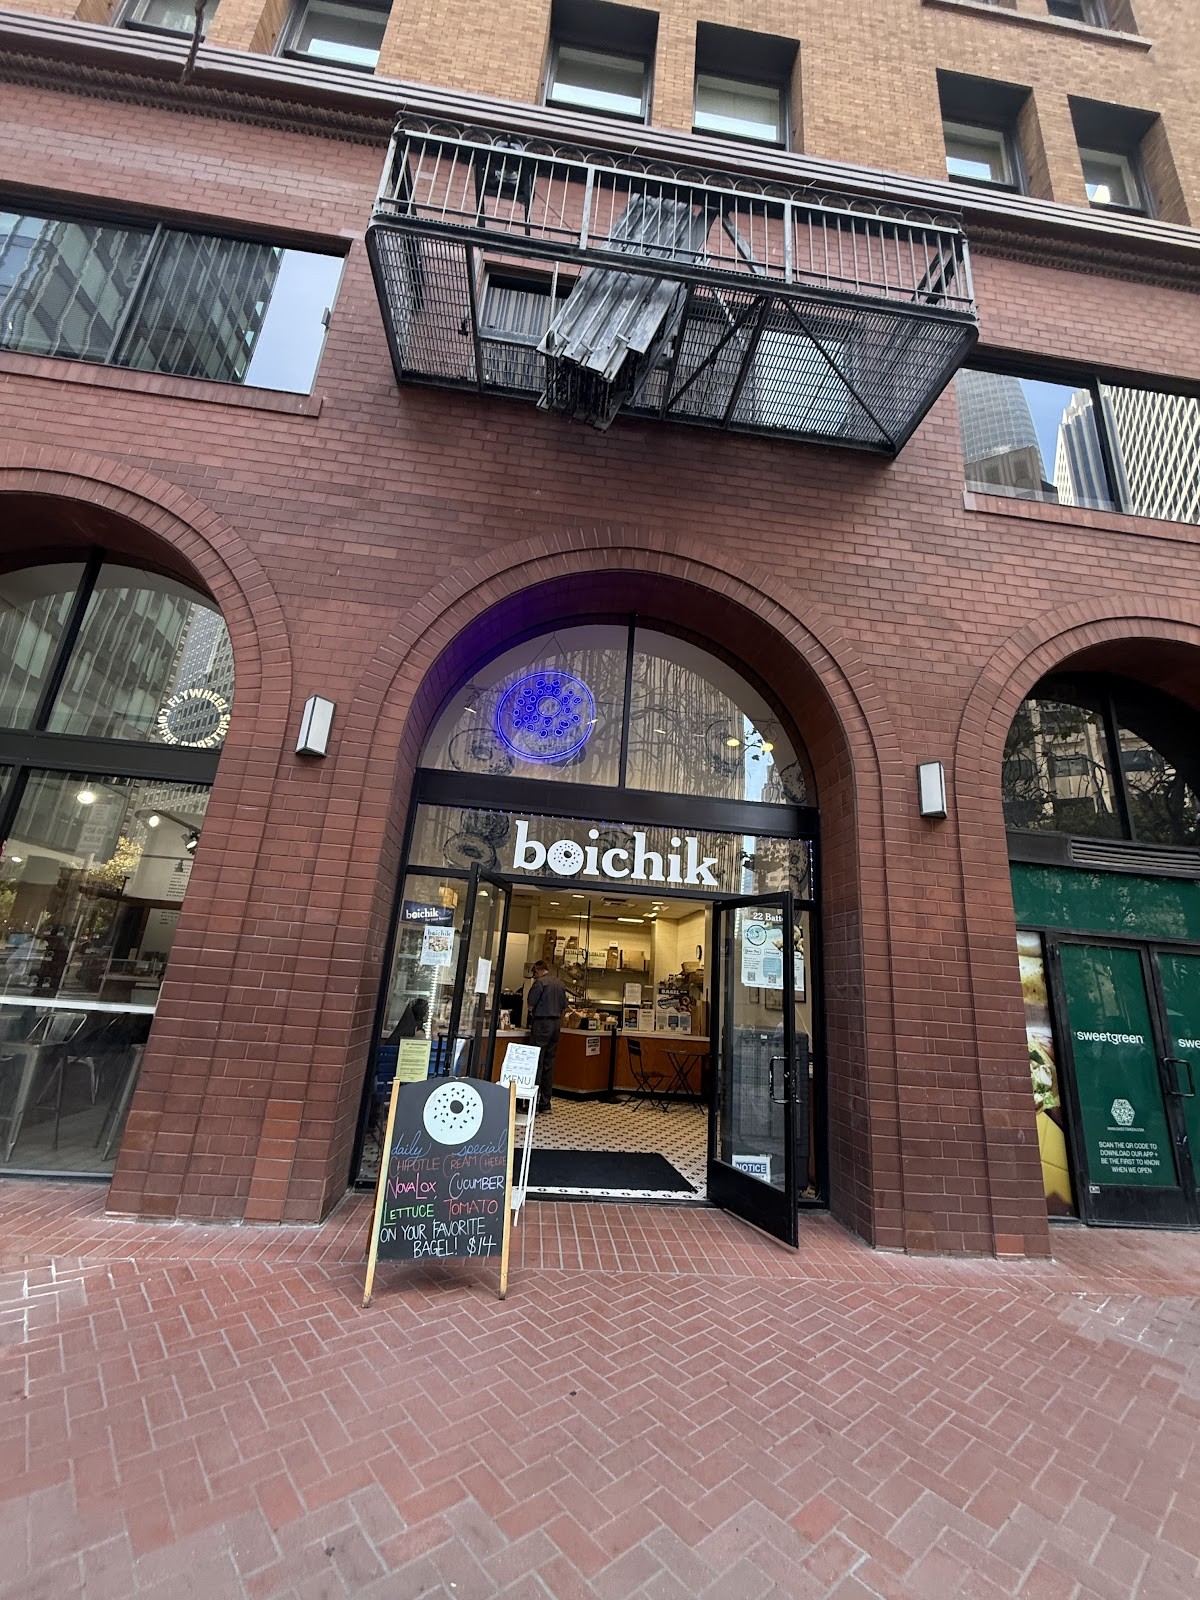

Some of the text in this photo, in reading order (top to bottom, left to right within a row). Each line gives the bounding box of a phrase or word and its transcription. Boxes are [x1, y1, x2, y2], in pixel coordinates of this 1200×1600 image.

[167, 688, 229, 713] FLYWHEEL
[157, 708, 179, 745] COFFEE
[513, 820, 719, 886] boichik
[405, 907, 439, 919] boichik
[752, 912, 764, 920] 22
[427, 929, 451, 937] boichik
[1076, 1031, 1144, 1045] sweetgreen
[502, 1073, 531, 1086] MENU
[391, 1129, 508, 1160] daily special
[736, 1163, 766, 1173] NOTICE
[380, 1217, 486, 1243] ON YOUR FAVORITE
[413, 1235, 497, 1259] BAGEL! $14
